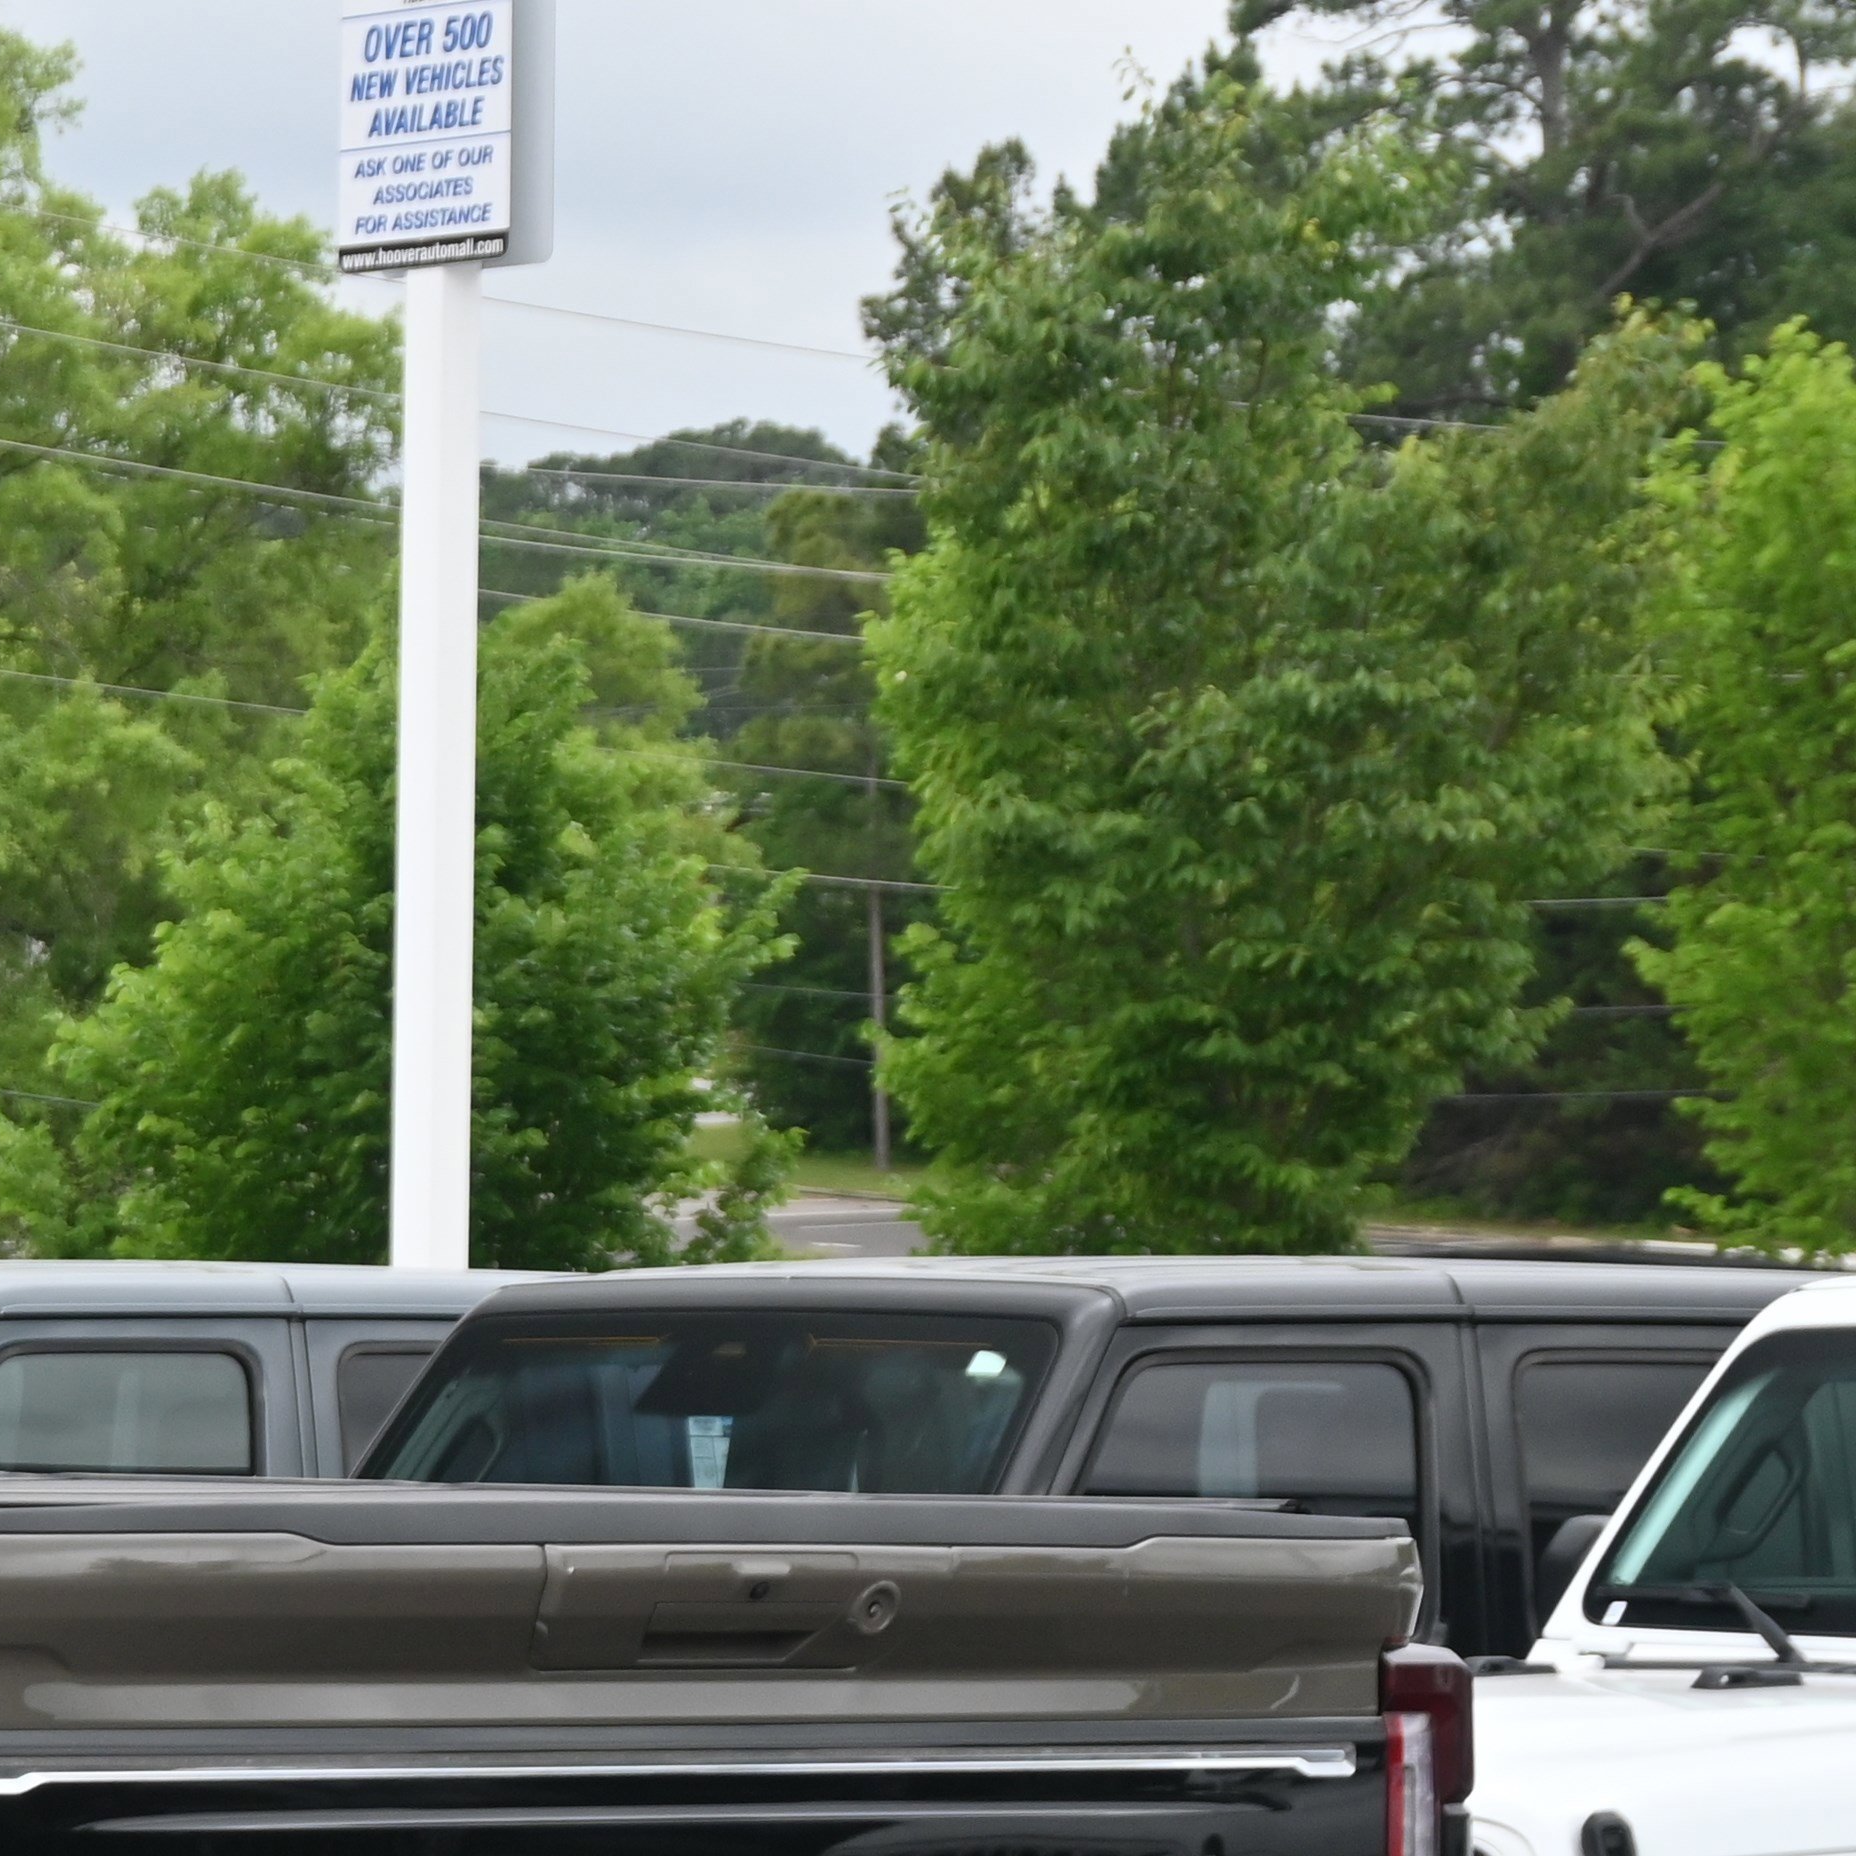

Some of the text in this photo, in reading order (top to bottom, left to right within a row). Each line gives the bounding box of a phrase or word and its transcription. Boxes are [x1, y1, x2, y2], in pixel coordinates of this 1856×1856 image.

[364, 10, 494, 63] OVER 500
[350, 54, 504, 102] NEW VEHICLES
[367, 95, 485, 138] AVAILABLE
[354, 144, 494, 179] ASK ONE OF OUR
[373, 175, 474, 205] ASSOCIATES
[354, 202, 492, 236] FOR ASSISTANCE
[341, 237, 504, 270] www.hooverautomall.com
